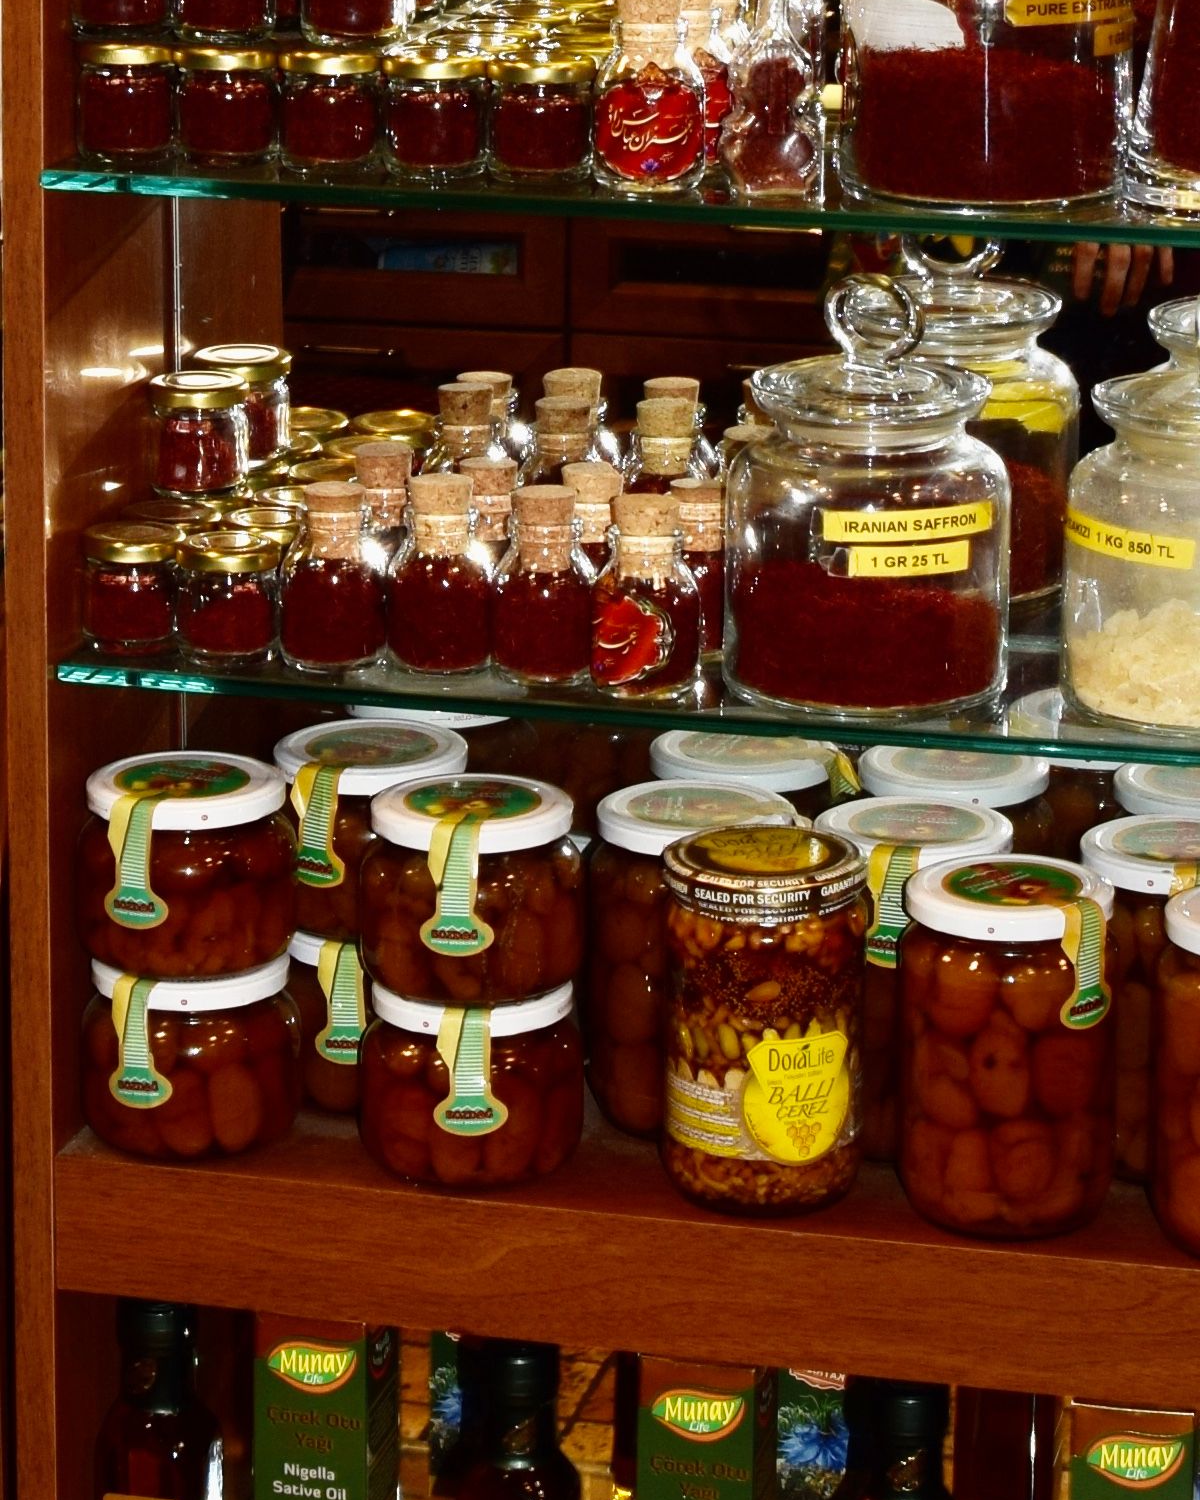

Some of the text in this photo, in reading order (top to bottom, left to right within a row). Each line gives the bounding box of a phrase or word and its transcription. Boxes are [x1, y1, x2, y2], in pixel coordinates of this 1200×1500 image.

[1025, 1, 1068, 18] PURE
[844, 512, 977, 534] IRANIAN SAFFRON
[1096, 531, 1101, 543] 1
[1105, 533, 1123, 549] KG
[1127, 540, 1152, 556] 850
[1156, 544, 1175, 559] TL
[871, 553, 950, 568] 1 GR 25 TL
[694, 887, 730, 904] SEALED
[732, 893, 755, 905] FOR
[757, 889, 811, 905] SECURITY
[768, 1077, 835, 1105] BALLI
[280, 1350, 347, 1377] Munay
[664, 1397, 735, 1425] Munay
[1100, 1444, 1174, 1471] Munay
[284, 1462, 335, 1481] Nigella
[273, 1480, 346, 1500] Sative Oil
